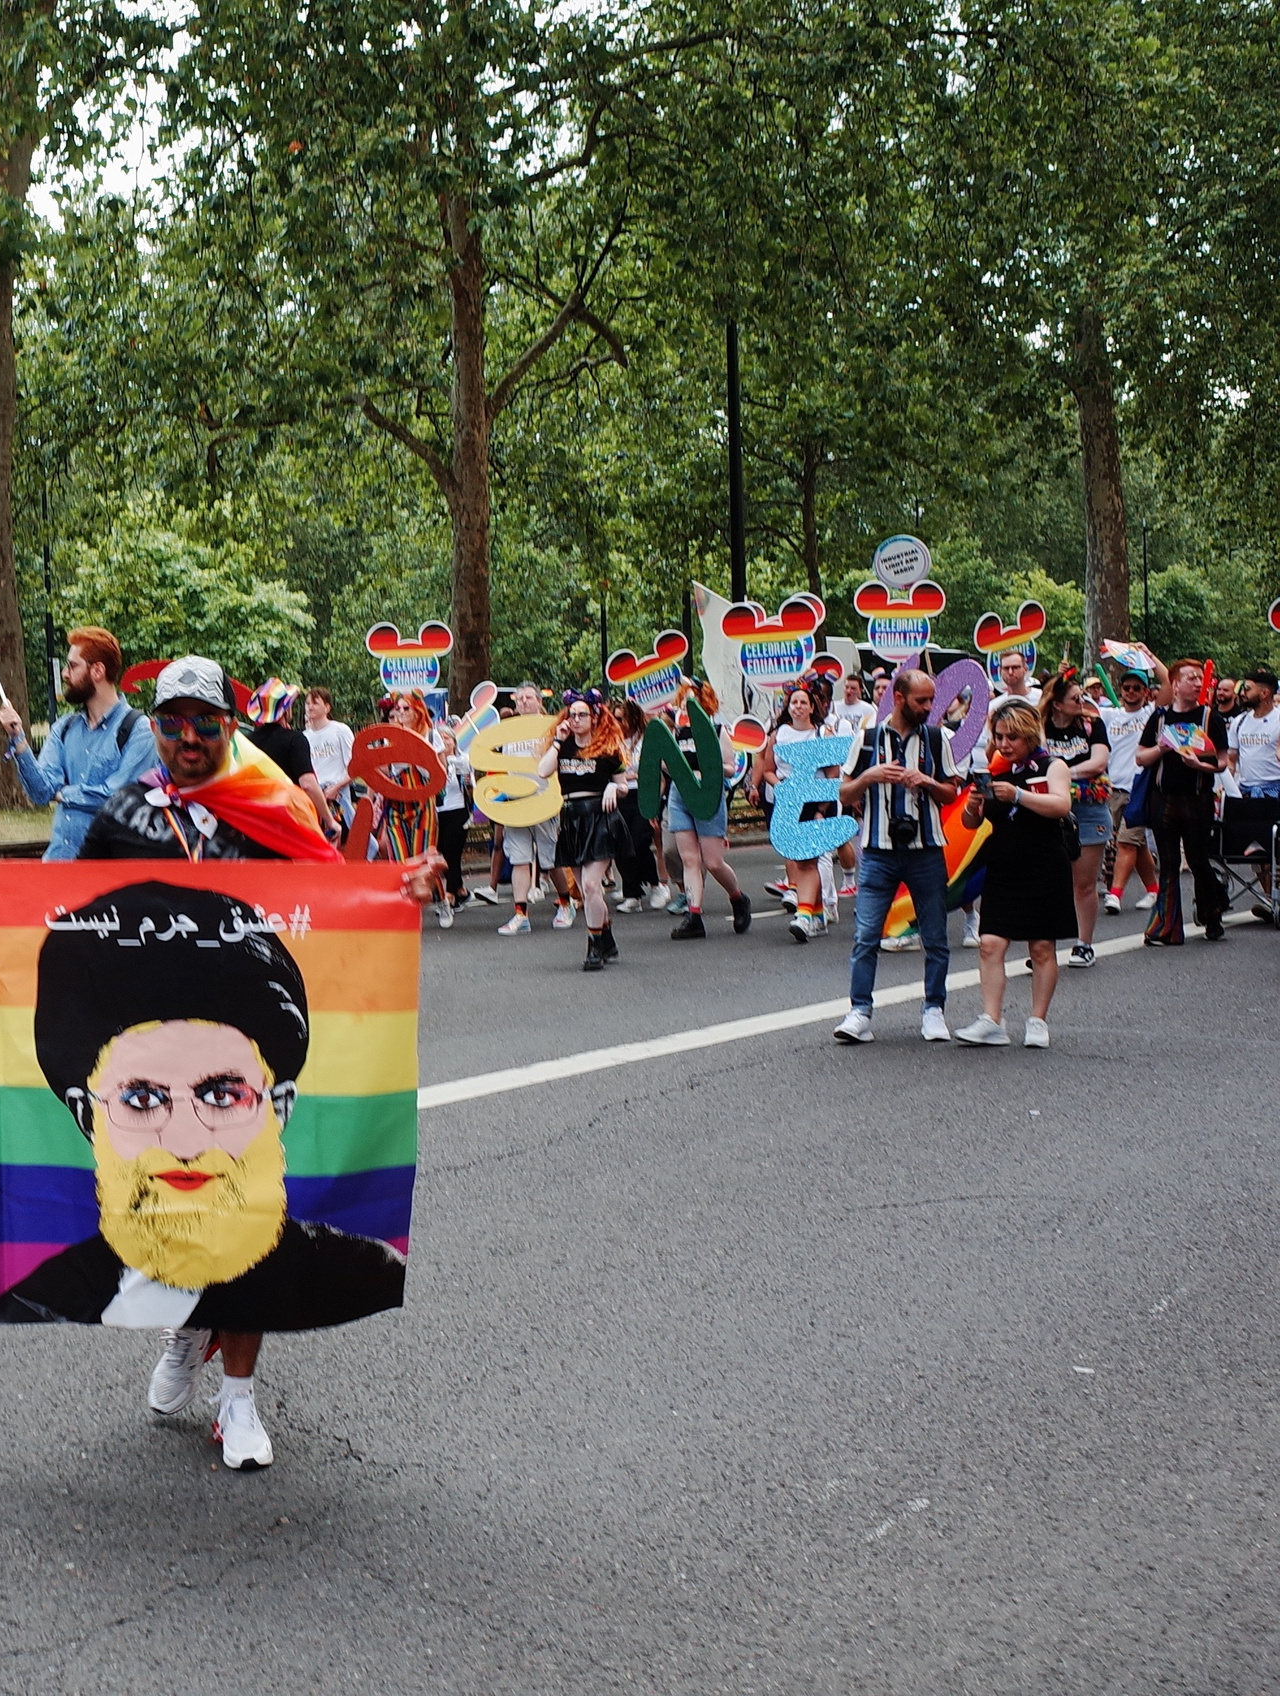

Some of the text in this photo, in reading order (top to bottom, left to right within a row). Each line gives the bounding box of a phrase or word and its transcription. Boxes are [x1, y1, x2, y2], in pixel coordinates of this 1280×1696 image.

[874, 617, 924, 633] CELEBRATE
[874, 632, 924, 647] EQUALITY
[745, 640, 799, 659] CELEBRATE
[386, 656, 434, 673] CELEBRATE
[746, 656, 799, 675] EQUALITY
[391, 670, 430, 686] CHANGE
[630, 664, 676, 693] CELEBRATE
